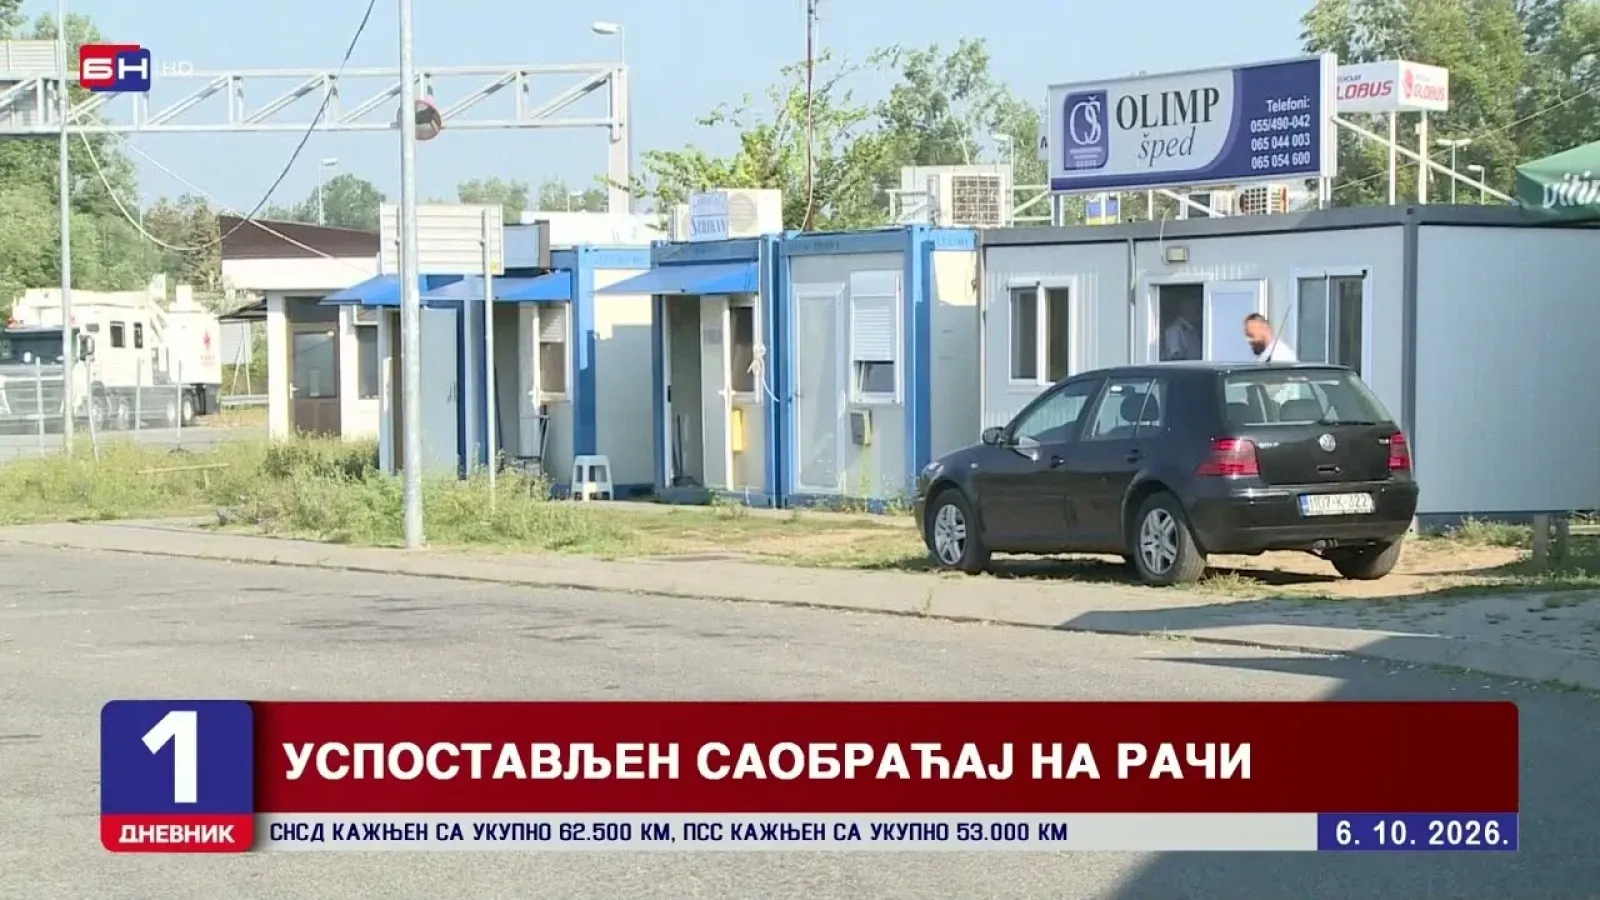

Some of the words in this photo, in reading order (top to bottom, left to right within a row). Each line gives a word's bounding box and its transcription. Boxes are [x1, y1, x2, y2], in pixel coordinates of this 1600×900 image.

[1337, 80, 1394, 101] LOBUS
[1116, 87, 1220, 131] OLIMP
[1266, 95, 1310, 113] Telefoni:
[1250, 114, 1311, 133] 055/490-042
[1138, 126, 1196, 167] šped
[1251, 136, 1270, 151] 065
[1271, 134, 1289, 149] 044
[1292, 132, 1311, 147] 003
[1251, 155, 1270, 170] 065
[1271, 153, 1289, 167] 054
[1292, 150, 1311, 166] 600
